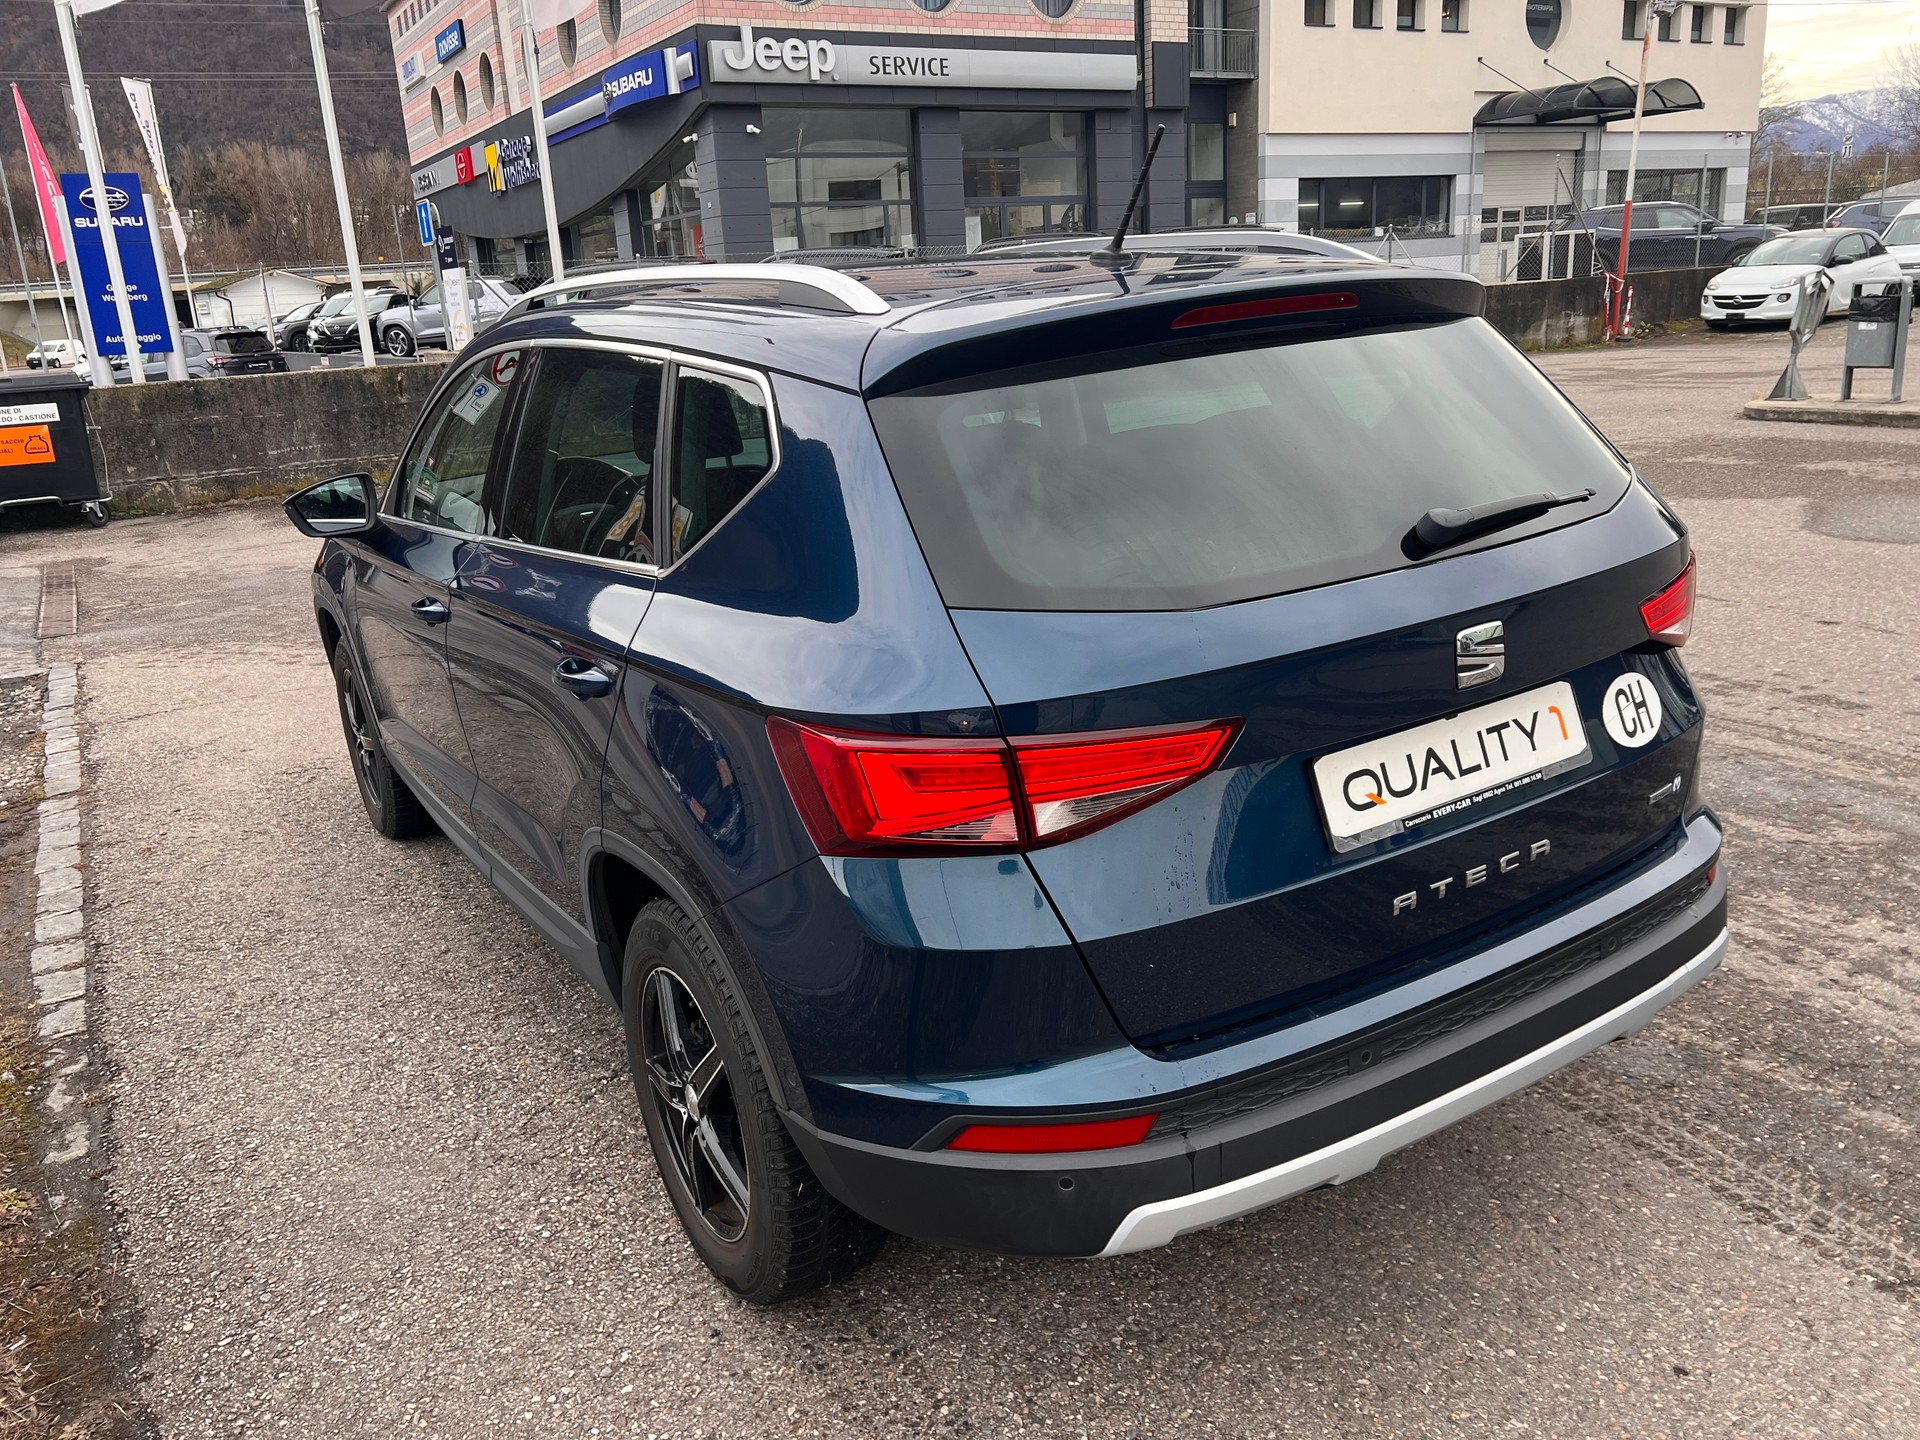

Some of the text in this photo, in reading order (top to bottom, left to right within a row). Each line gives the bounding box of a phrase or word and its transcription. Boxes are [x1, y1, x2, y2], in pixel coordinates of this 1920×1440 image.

[438, 30, 459, 58] novisse
[723, 25, 836, 80] Jeep
[869, 55, 950, 77] SERVICE
[611, 67, 653, 98] SUBARU
[74, 216, 144, 228] SUARU
[18, 412, 57, 422] CASTIONE
[1614, 679, 1654, 739] CH
[1404, 813, 1432, 828] Carrozzeria
[1432, 798, 1472, 819] EVERY-CAR
[1393, 838, 1551, 917] ATECA
